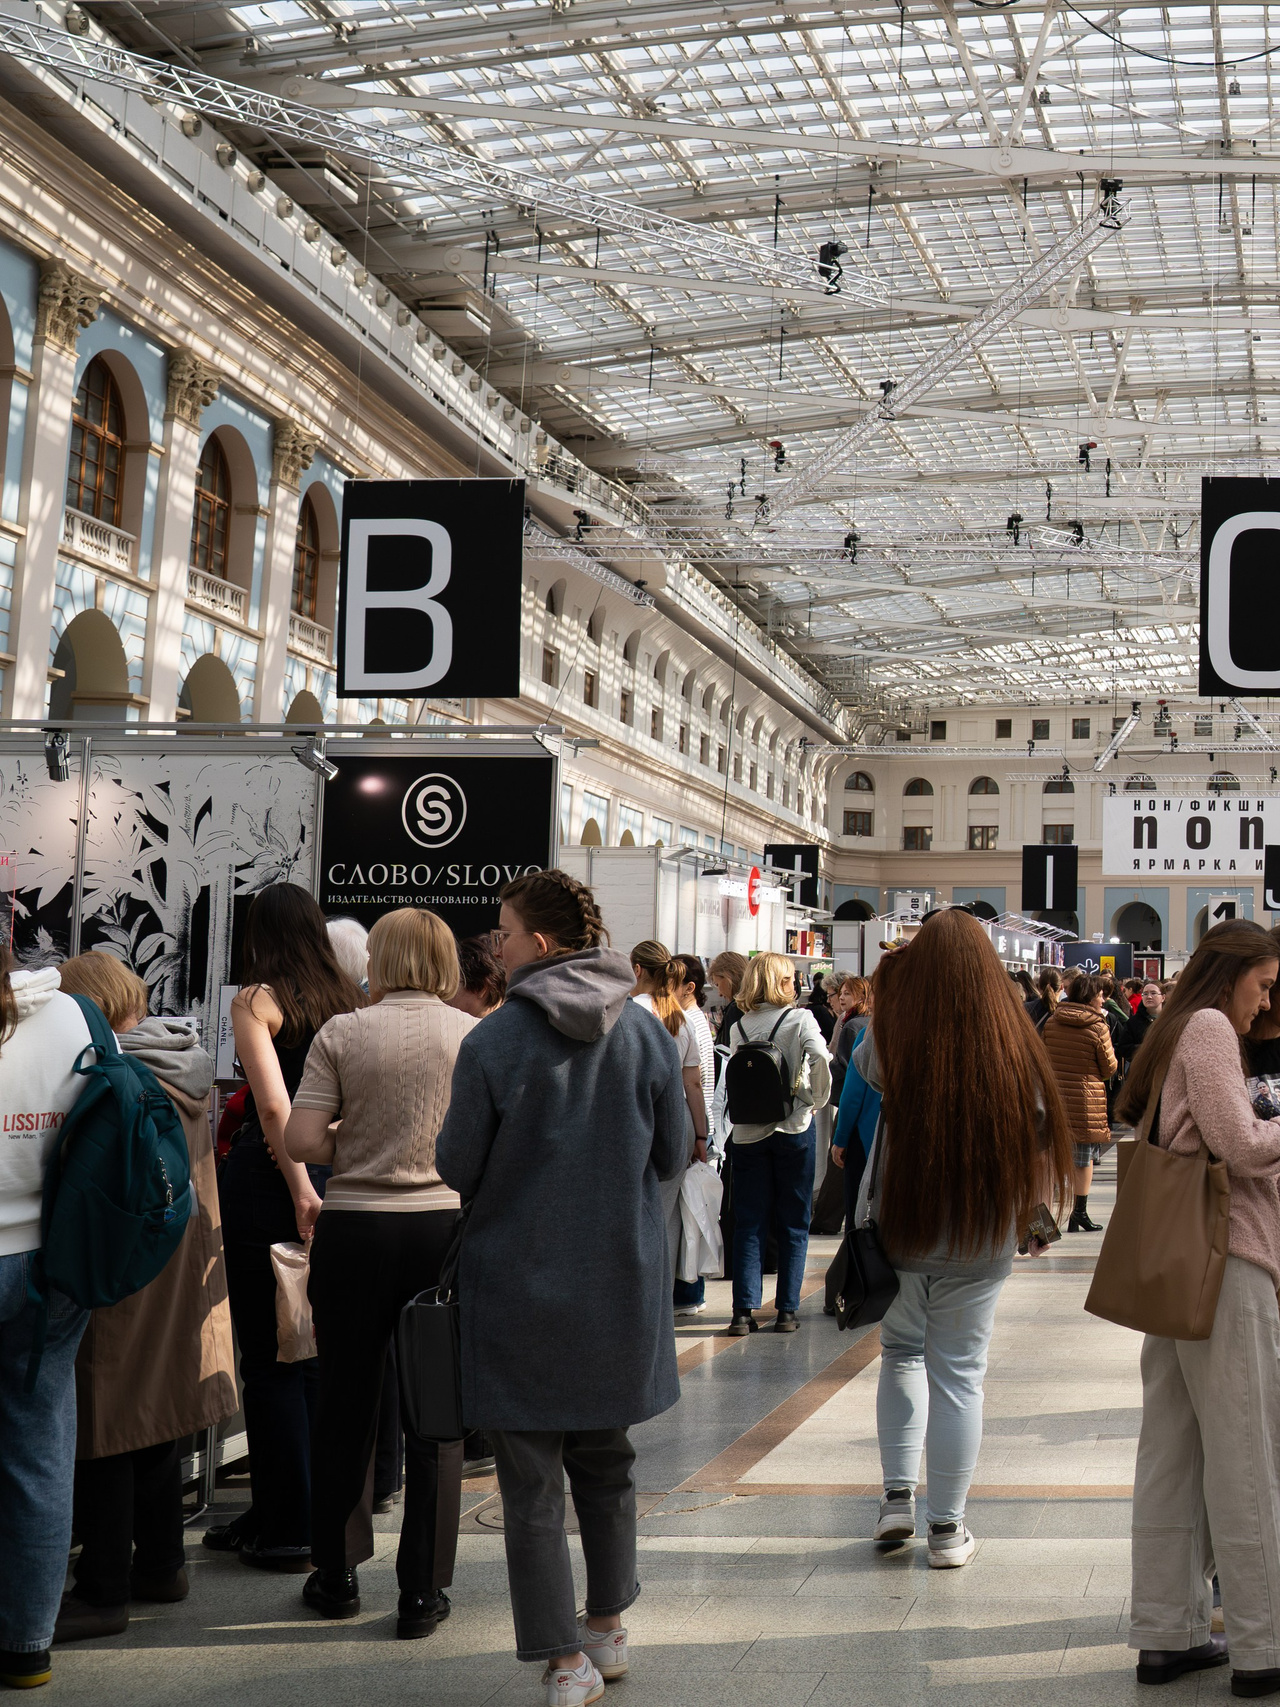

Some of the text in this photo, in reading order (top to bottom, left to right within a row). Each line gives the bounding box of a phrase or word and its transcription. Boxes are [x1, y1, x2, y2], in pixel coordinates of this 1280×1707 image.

[344, 518, 454, 691] B
[1133, 858, 1237, 871] ЯРМАРКА
[327, 894, 413, 904] ИЗДАТЕЛЬСТВО
[415, 895, 479, 905] ОСНОВАНО
[481, 896, 488, 904] В
[220, 1016, 228, 1047] CHANEL
[3, 1111, 69, 1132] LISSITZKY
